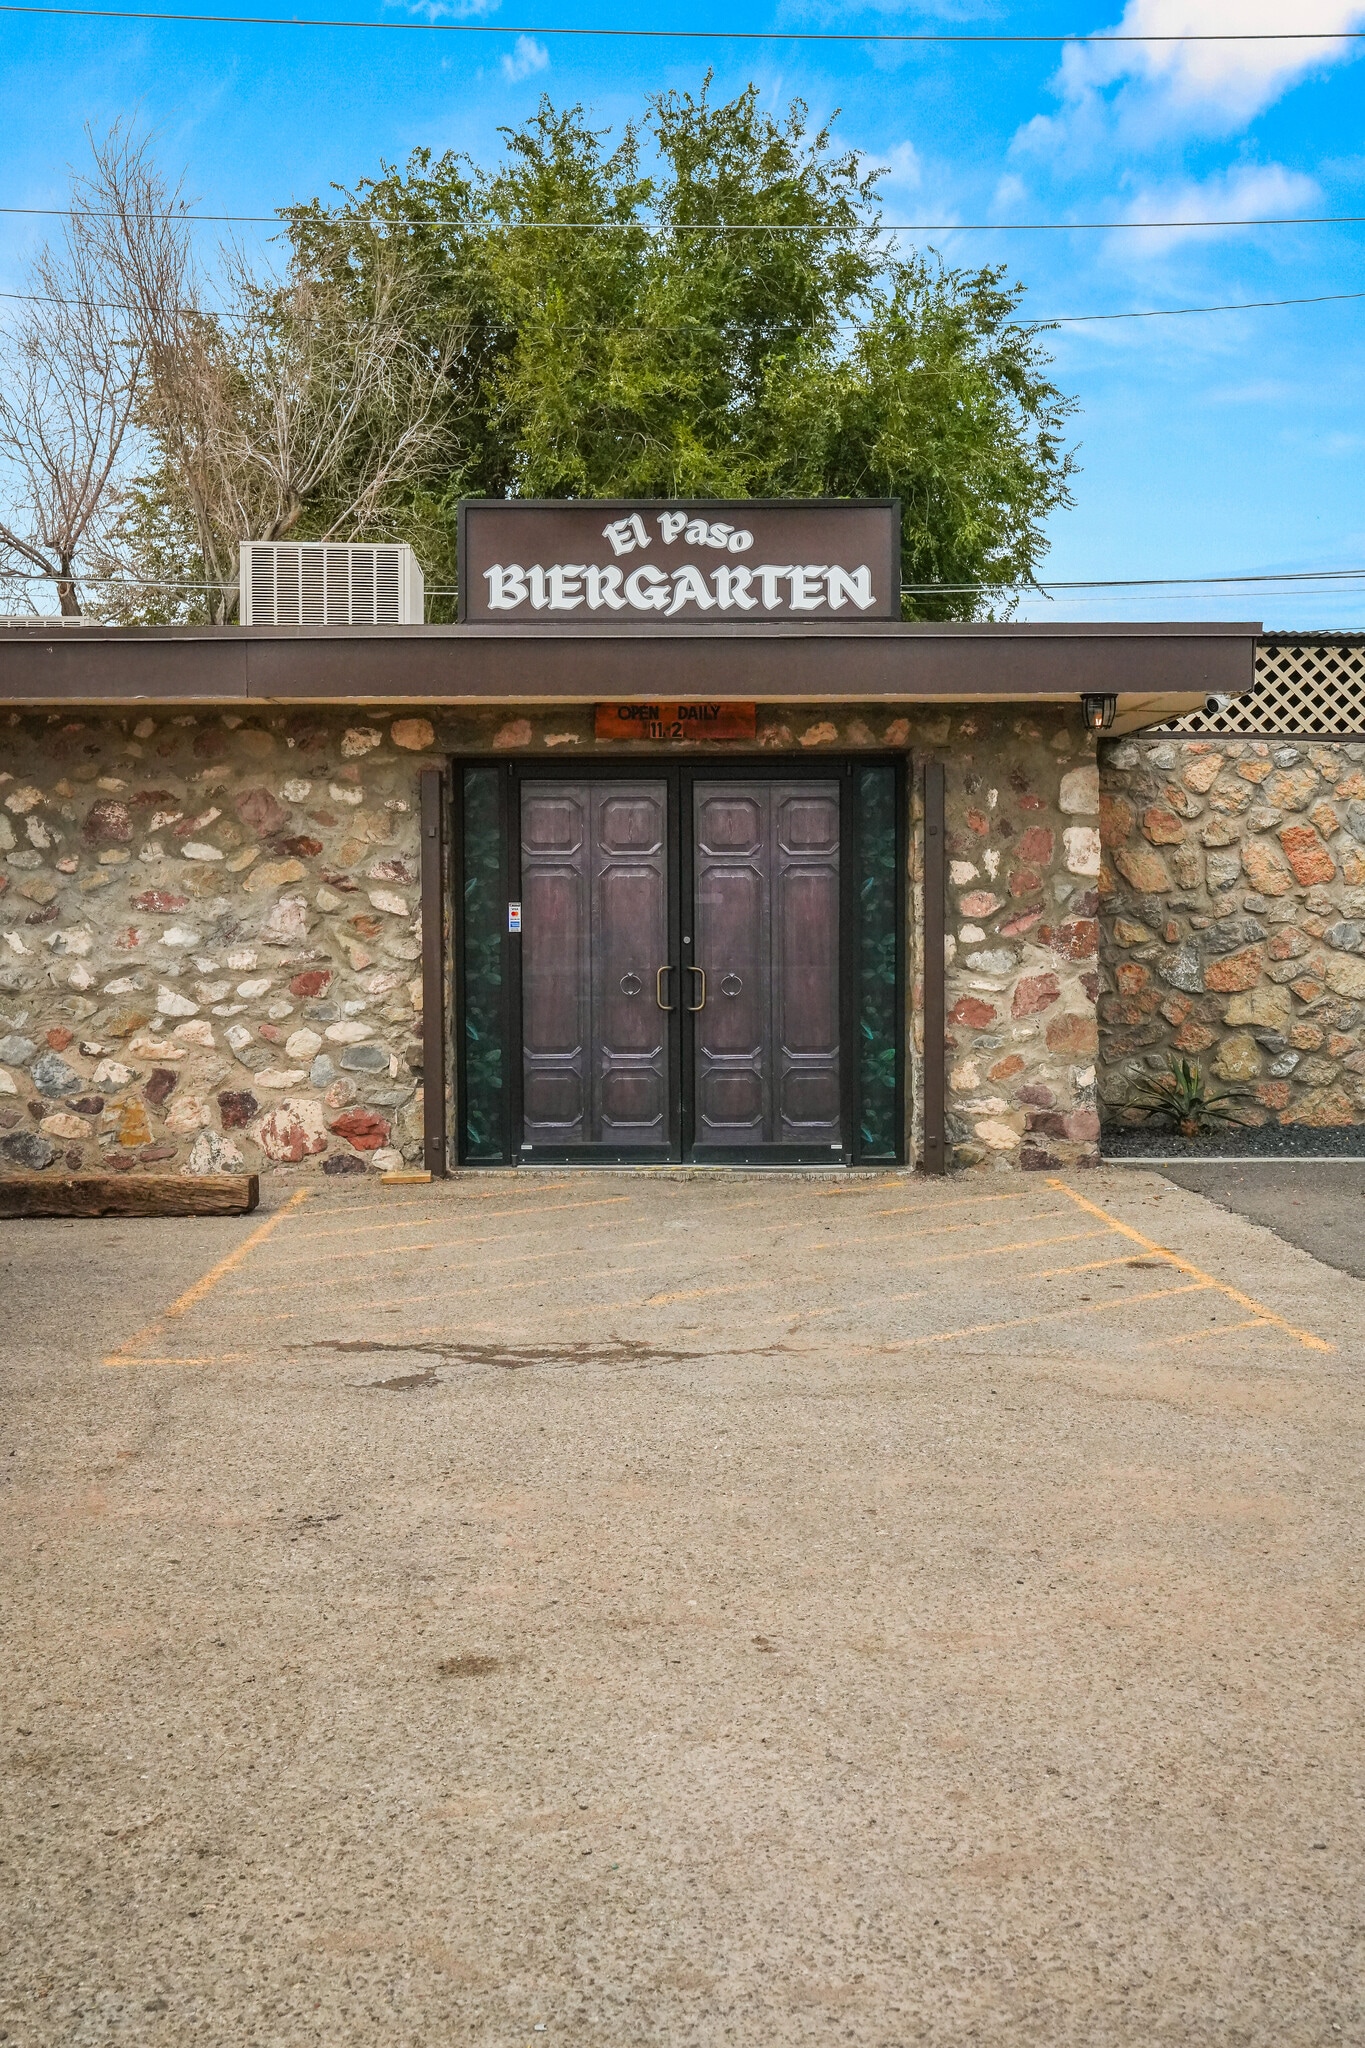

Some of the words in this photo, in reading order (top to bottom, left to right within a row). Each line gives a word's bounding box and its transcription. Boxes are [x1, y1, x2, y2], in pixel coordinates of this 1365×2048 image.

[602, 513, 652, 556] El
[657, 511, 754, 553] Paso
[483, 564, 876, 616] BIERGARTEN
[617, 705, 659, 720] OPEN
[678, 705, 721, 720] DAILY
